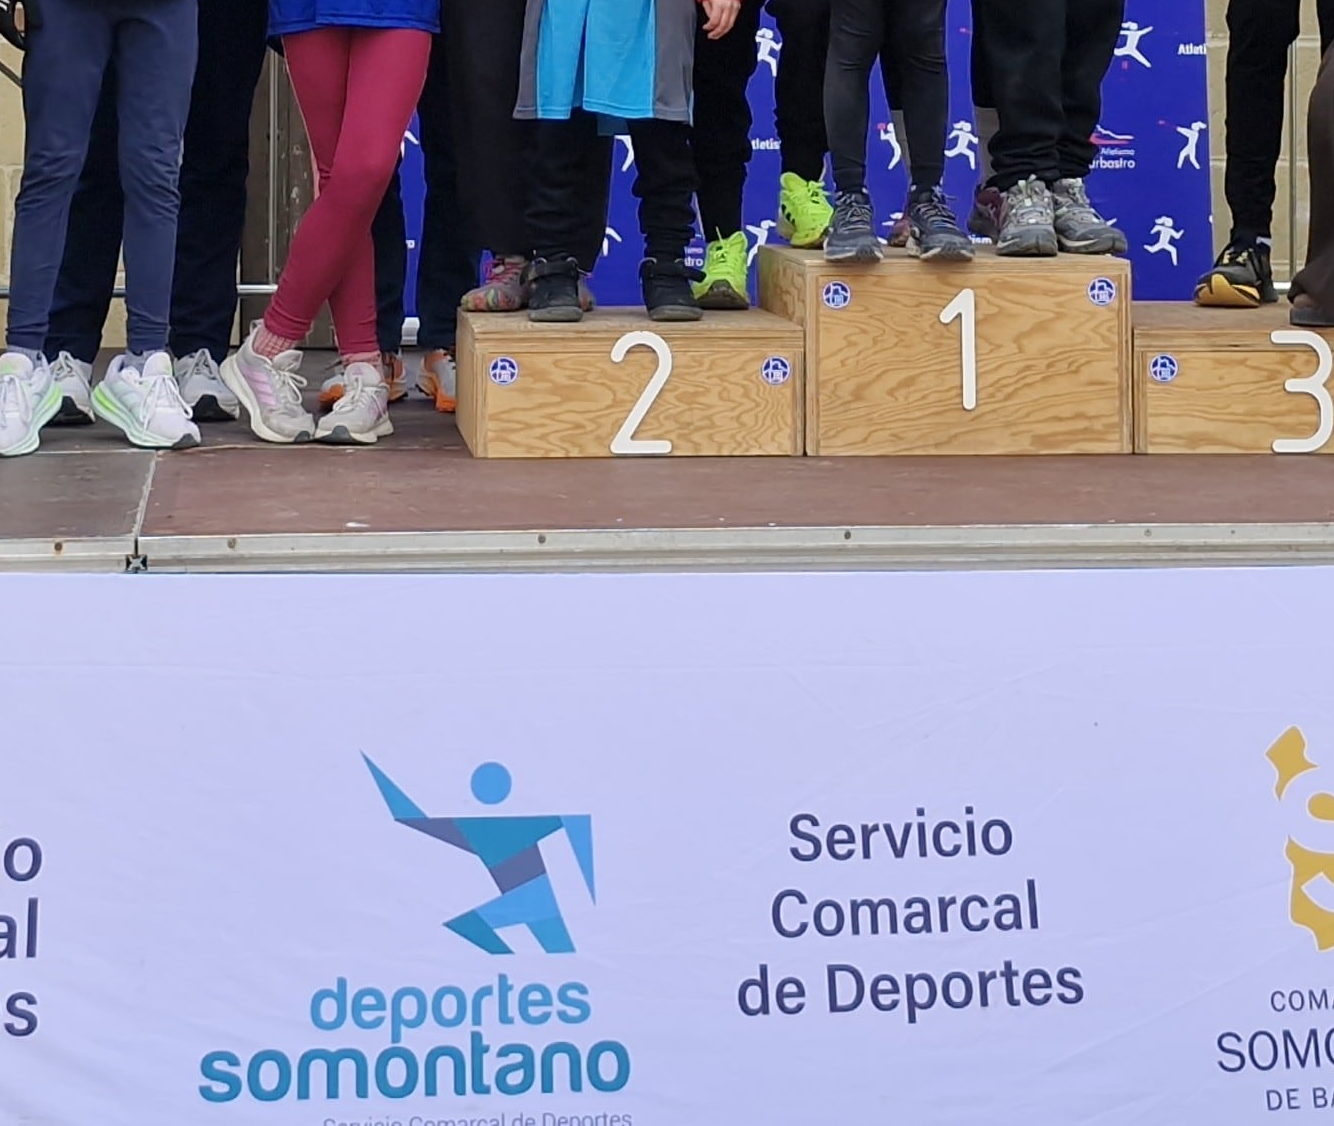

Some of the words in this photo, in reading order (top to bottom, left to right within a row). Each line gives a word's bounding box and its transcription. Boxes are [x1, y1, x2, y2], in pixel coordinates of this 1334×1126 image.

[938, 288, 977, 411] 1
[609, 330, 673, 454] 2
[1269, 330, 1334, 454] 3
[789, 805, 1013, 862] Servicio
[771, 878, 1039, 939] Comarcal
[309, 972, 592, 1045] deportes
[737, 963, 806, 1017] de
[826, 960, 1085, 1025] Deportes
[198, 1030, 631, 1104] somontano
[1265, 1088, 1301, 1112] DE
